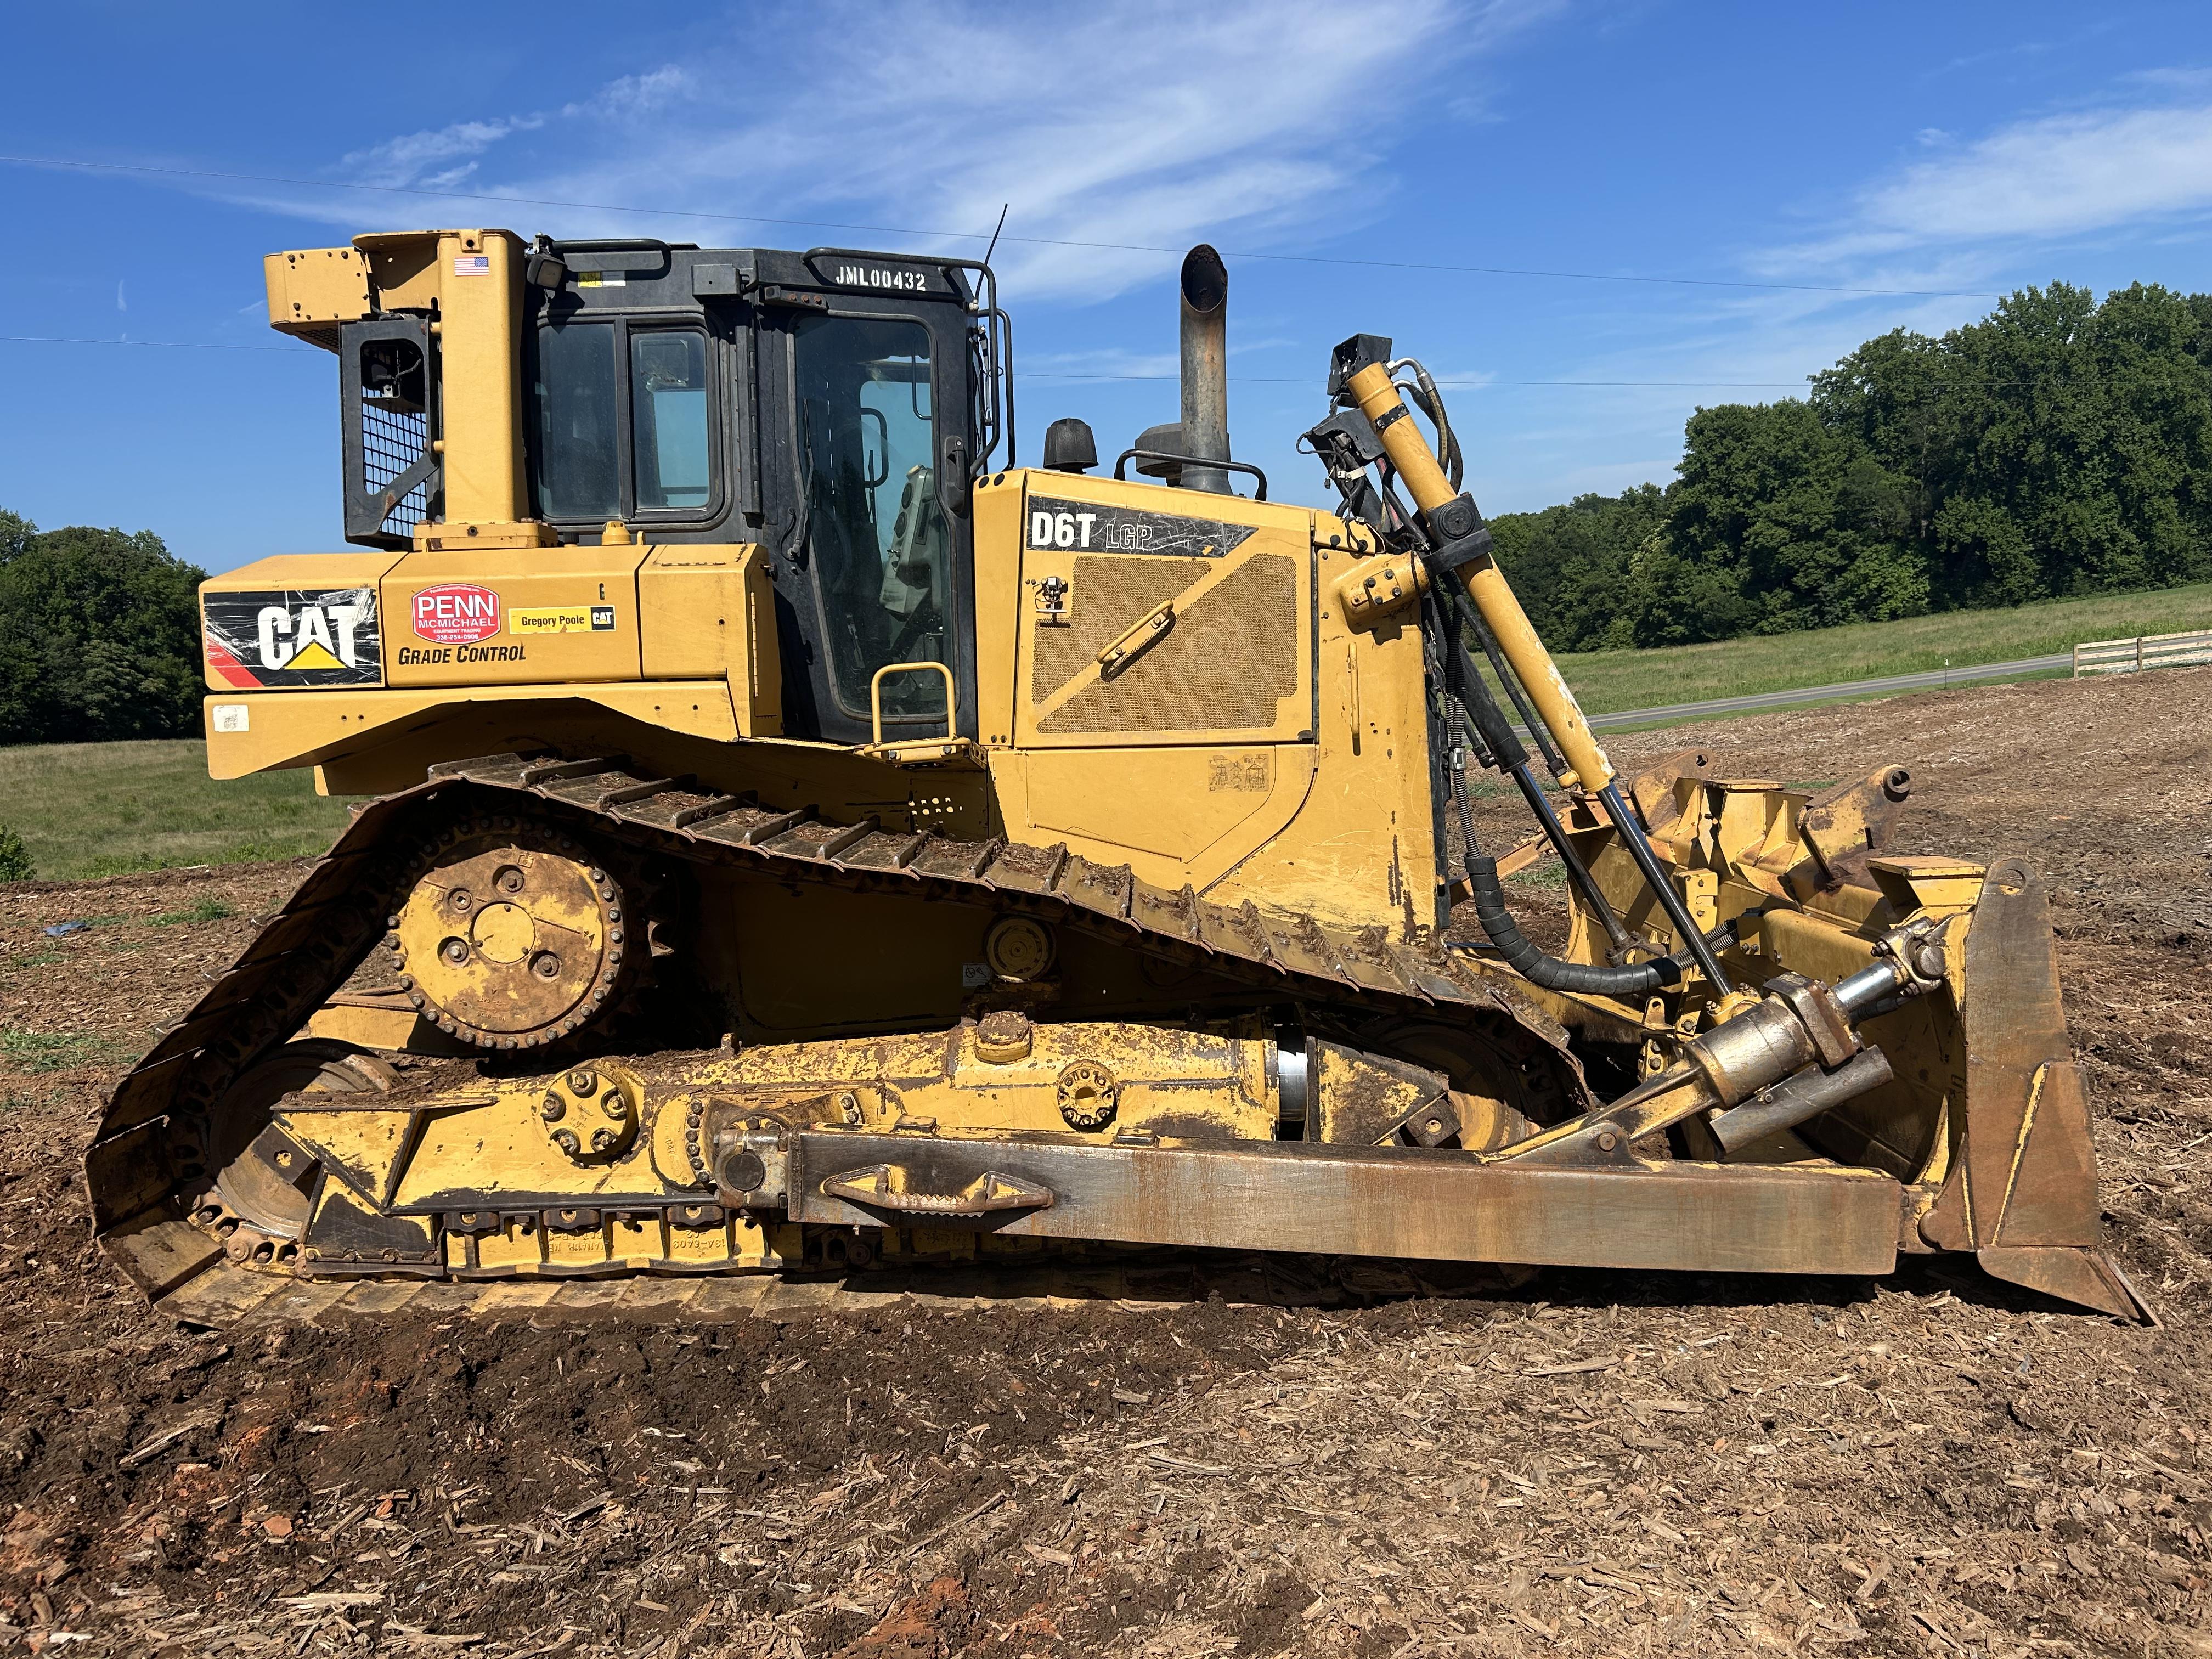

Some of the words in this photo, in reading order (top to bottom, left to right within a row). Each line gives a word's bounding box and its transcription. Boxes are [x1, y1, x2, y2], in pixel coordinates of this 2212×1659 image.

[836, 266, 926, 291] JML00432
[1031, 511, 1097, 548] D6T
[1106, 523, 1153, 550] LGP
[417, 594, 494, 619] PENN
[418, 618, 495, 628] MCMICHAEL
[521, 616, 556, 627] Gregory
[559, 615, 585, 625] Poole
[592, 612, 612, 625] CAT
[257, 605, 362, 670] CAT
[398, 647, 452, 665] GRADE
[456, 645, 527, 663] CONTROL
